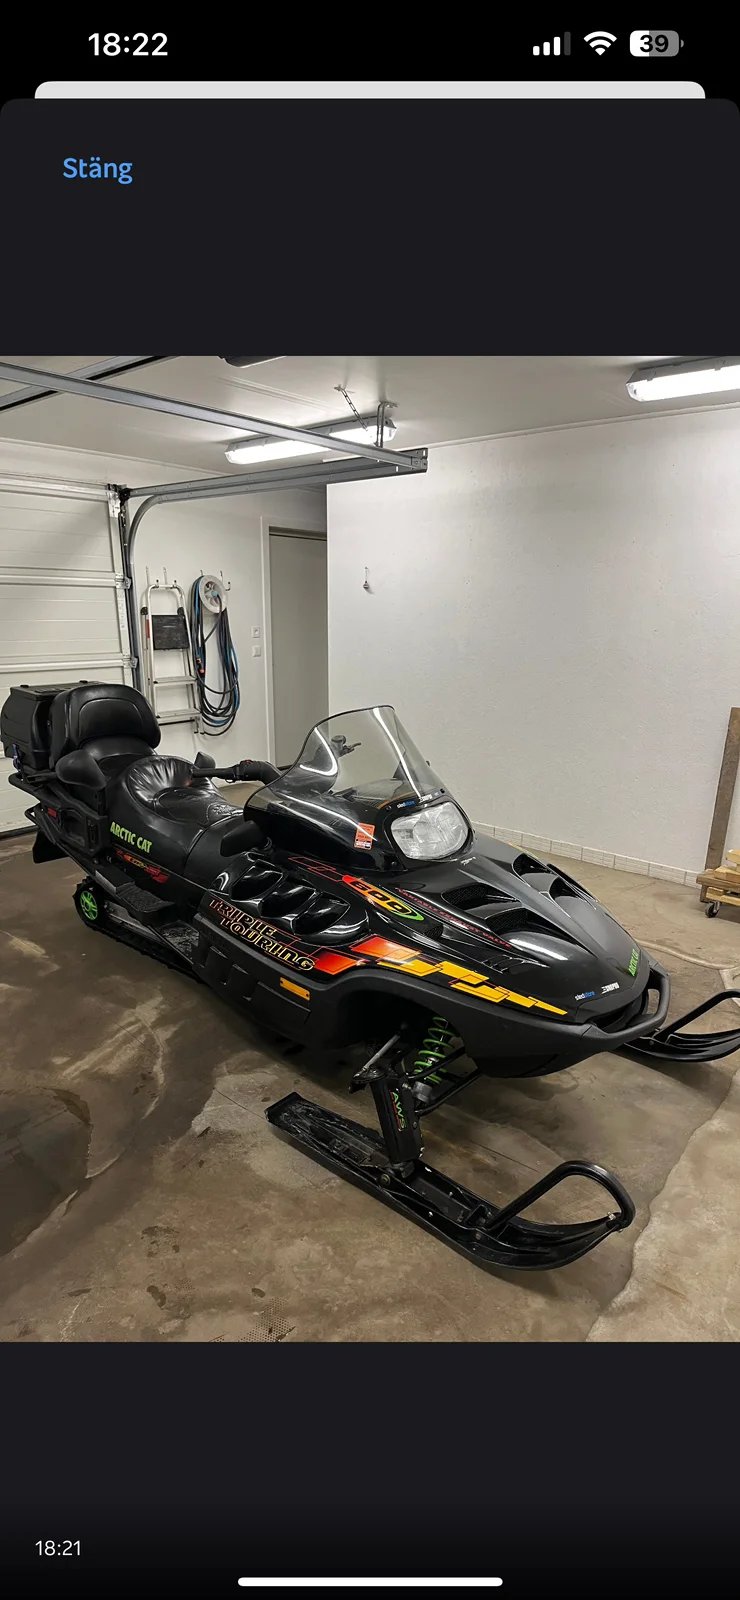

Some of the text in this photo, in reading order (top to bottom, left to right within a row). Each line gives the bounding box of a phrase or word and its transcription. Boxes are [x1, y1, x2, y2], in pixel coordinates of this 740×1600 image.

[110, 821, 153, 854] ARCTIC CAT
[391, 1091, 407, 1129] AWS
